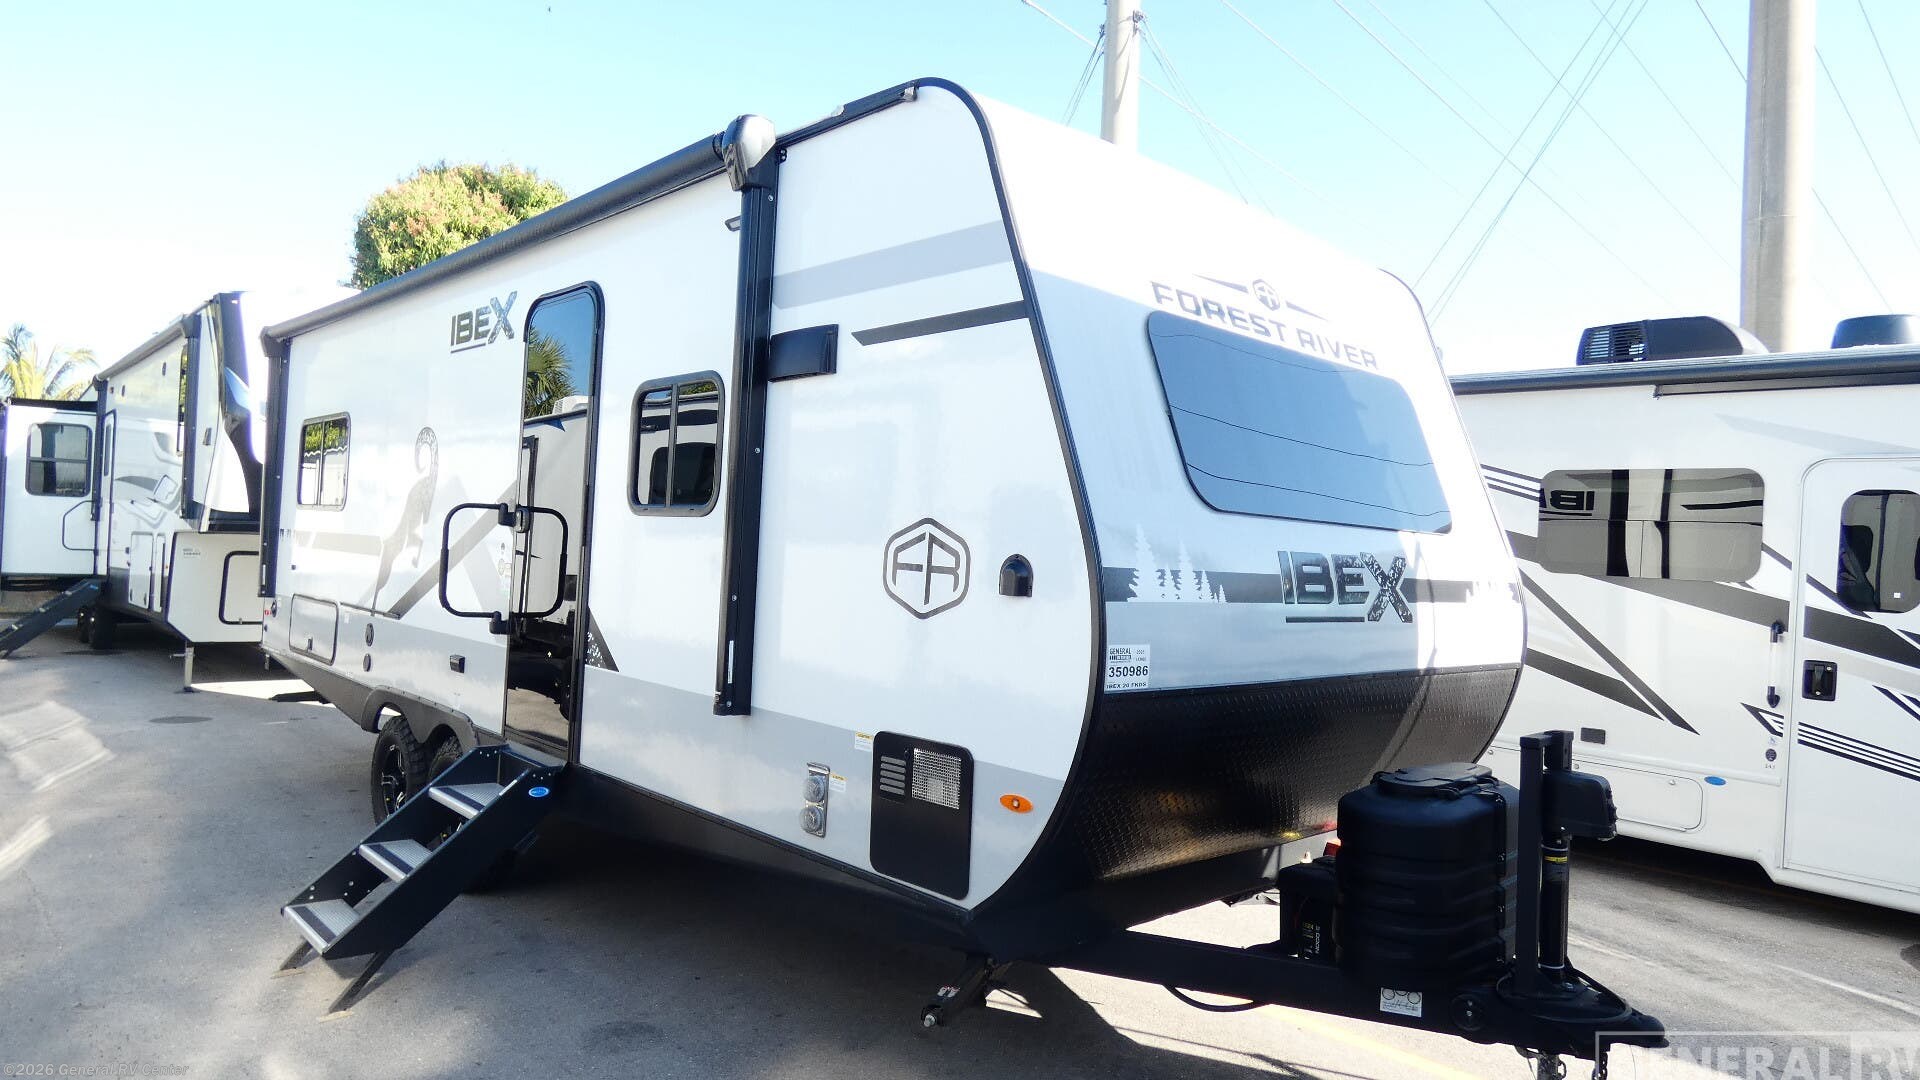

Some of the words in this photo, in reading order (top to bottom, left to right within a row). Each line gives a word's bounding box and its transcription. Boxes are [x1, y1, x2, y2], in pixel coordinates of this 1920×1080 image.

[451, 291, 518, 346] IBEX
[1150, 281, 1286, 342] FOREST
[1296, 327, 1378, 370] RIVER
[1277, 551, 1413, 623] IBEX
[1108, 665, 1149, 678] 350986
